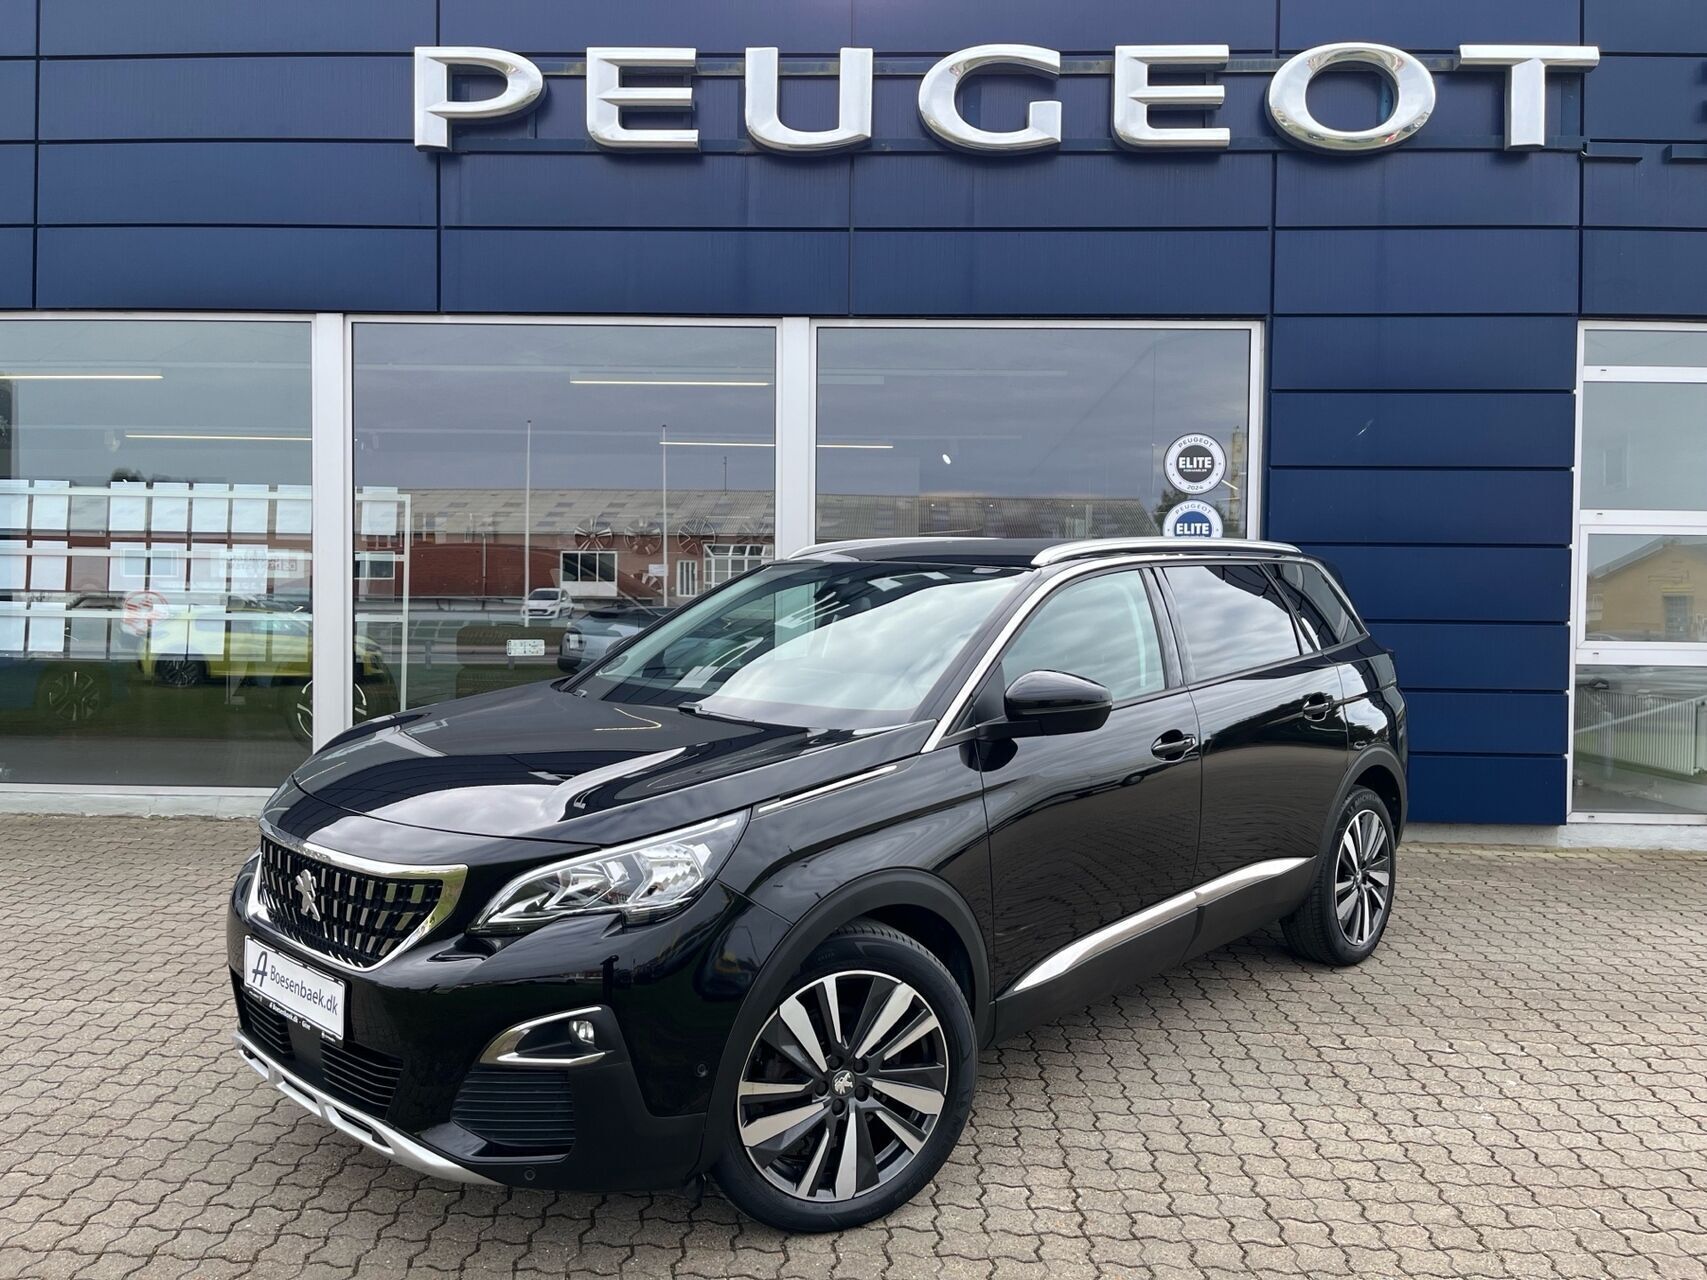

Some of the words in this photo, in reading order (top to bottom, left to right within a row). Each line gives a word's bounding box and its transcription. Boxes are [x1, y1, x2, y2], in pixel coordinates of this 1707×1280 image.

[414, 43, 1600, 153] PEUGEOT
[1178, 437, 1214, 449] PEUGEOT
[1178, 456, 1212, 469] ELITE
[1175, 503, 1212, 515] PEUGEOT
[1176, 522, 1210, 535] ELITE
[270, 964, 338, 1016] Boesenbaek.dk
